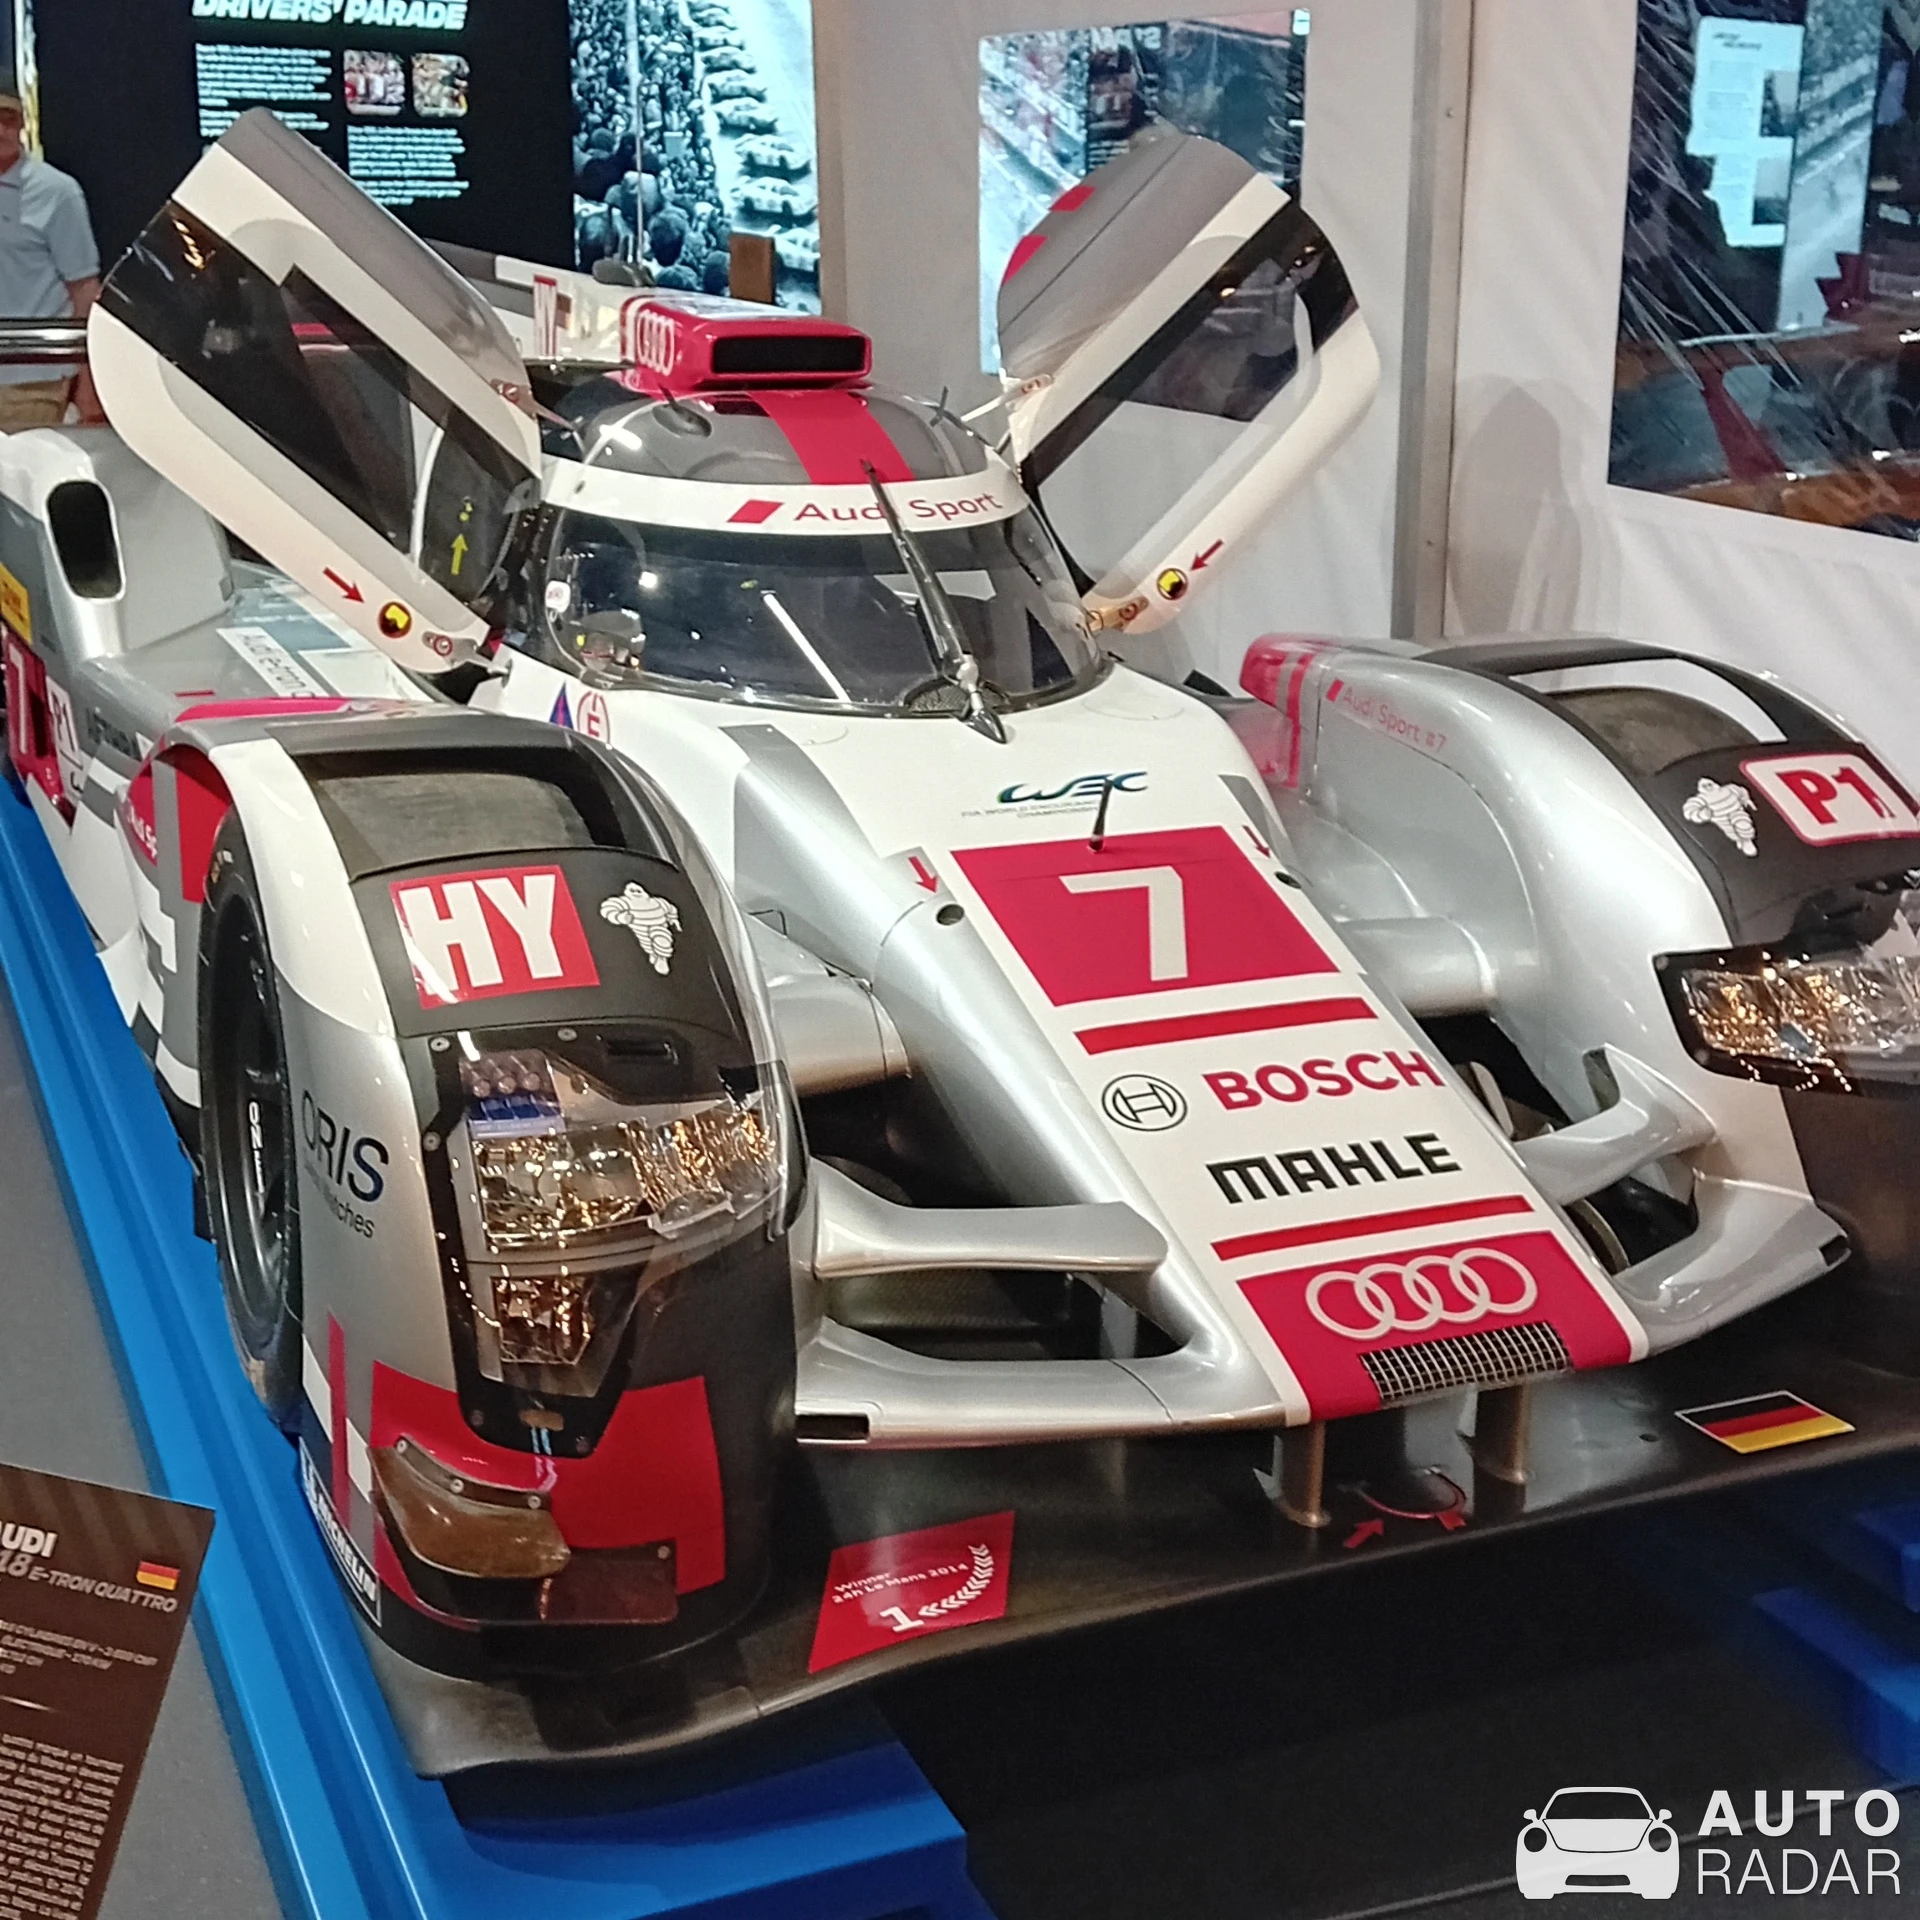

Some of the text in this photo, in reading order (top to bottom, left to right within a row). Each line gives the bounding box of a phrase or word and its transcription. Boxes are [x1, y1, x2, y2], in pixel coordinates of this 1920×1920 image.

[343, 0, 466, 30] PARADE
[794, 493, 1003, 521] Aud Sport
[8, 643, 27, 755] 7
[1344, 686, 1371, 716] Audi
[1378, 703, 1420, 742] Sport
[1775, 767, 1895, 825] P1
[398, 874, 563, 996] HY
[1058, 865, 1188, 982] 7
[1202, 1051, 1446, 1111] BOSCH
[302, 1090, 389, 1202] ORIS
[1206, 1133, 1462, 1204] MAHLE
[0, 1521, 58, 1558] UDI
[28, 1565, 96, 1595] E-TRON
[94, 1581, 178, 1613] QUATTRO
[832, 1563, 969, 1603] 24h Le Mans 2014
[834, 1572, 891, 1593] Winner
[879, 1605, 925, 1633] 1
